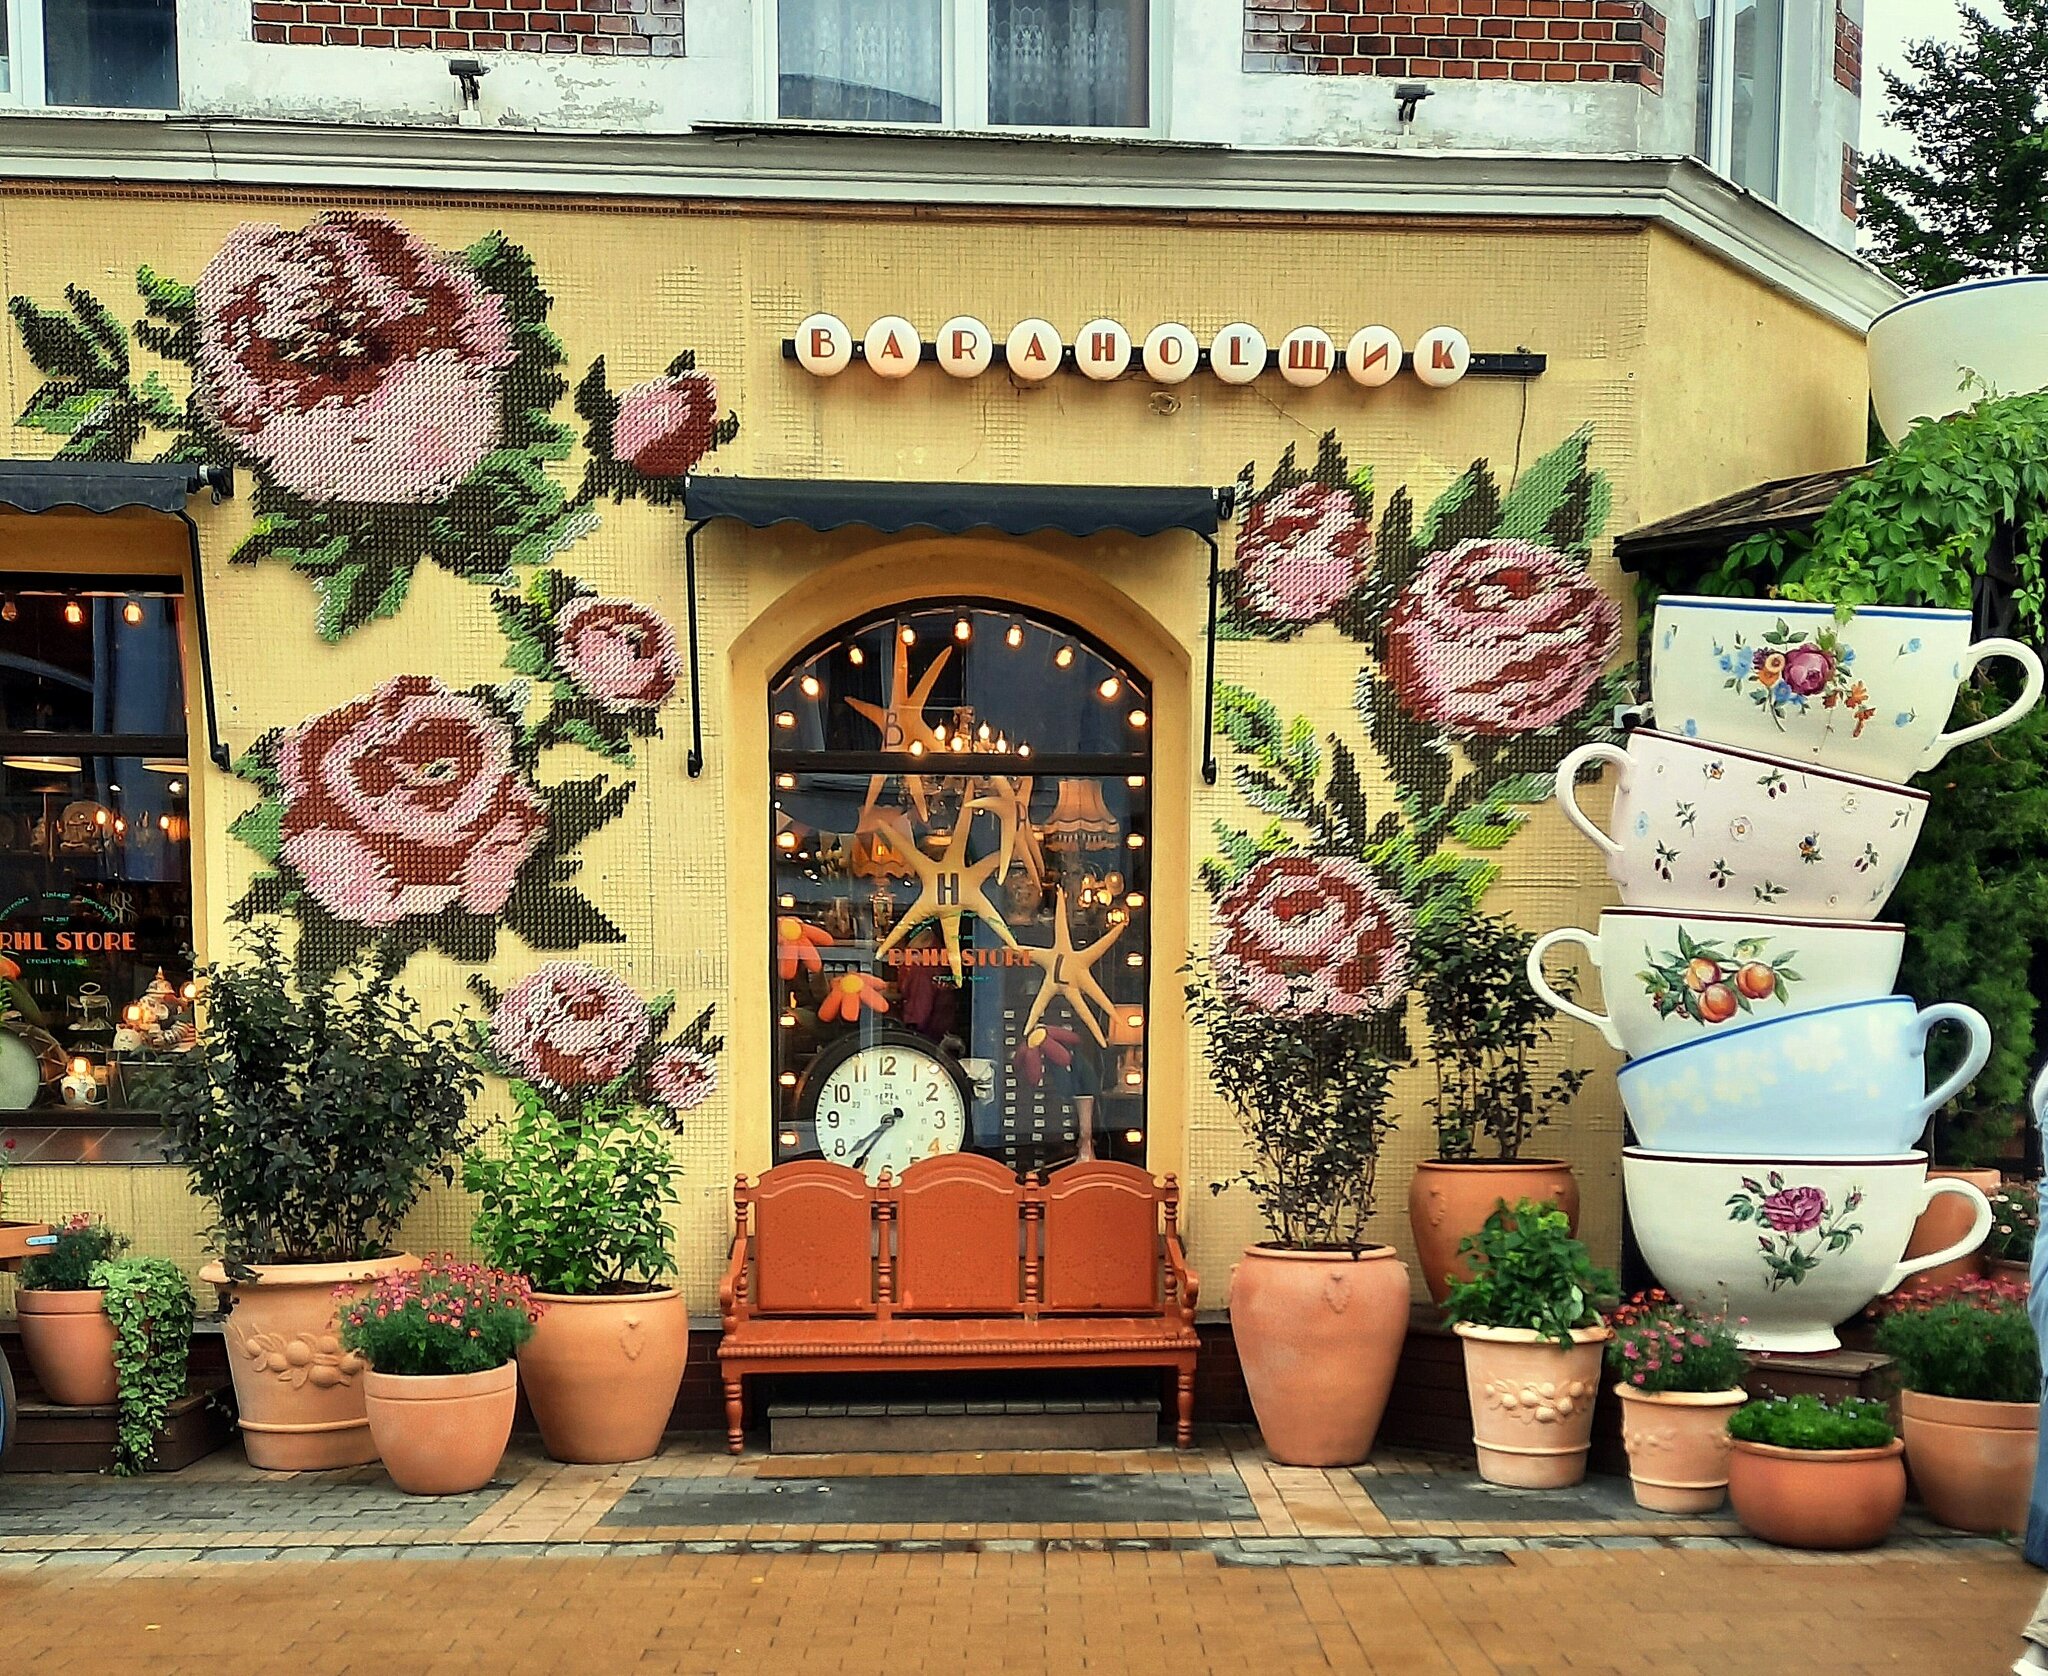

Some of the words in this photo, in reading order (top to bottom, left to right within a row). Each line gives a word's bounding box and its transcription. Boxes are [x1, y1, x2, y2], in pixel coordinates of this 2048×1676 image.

[884, 712, 903, 749] B
[937, 873, 959, 905] H
[56, 931, 136, 951] STORE
[1054, 953, 1069, 985] L
[879, 1056, 897, 1076] 12
[834, 1084, 850, 1103] 10
[926, 1082, 939, 1102] 2
[827, 1110, 840, 1129] 9
[934, 1110, 946, 1129] 3
[834, 1138, 846, 1157] 8
[927, 1136, 941, 1156] 4
